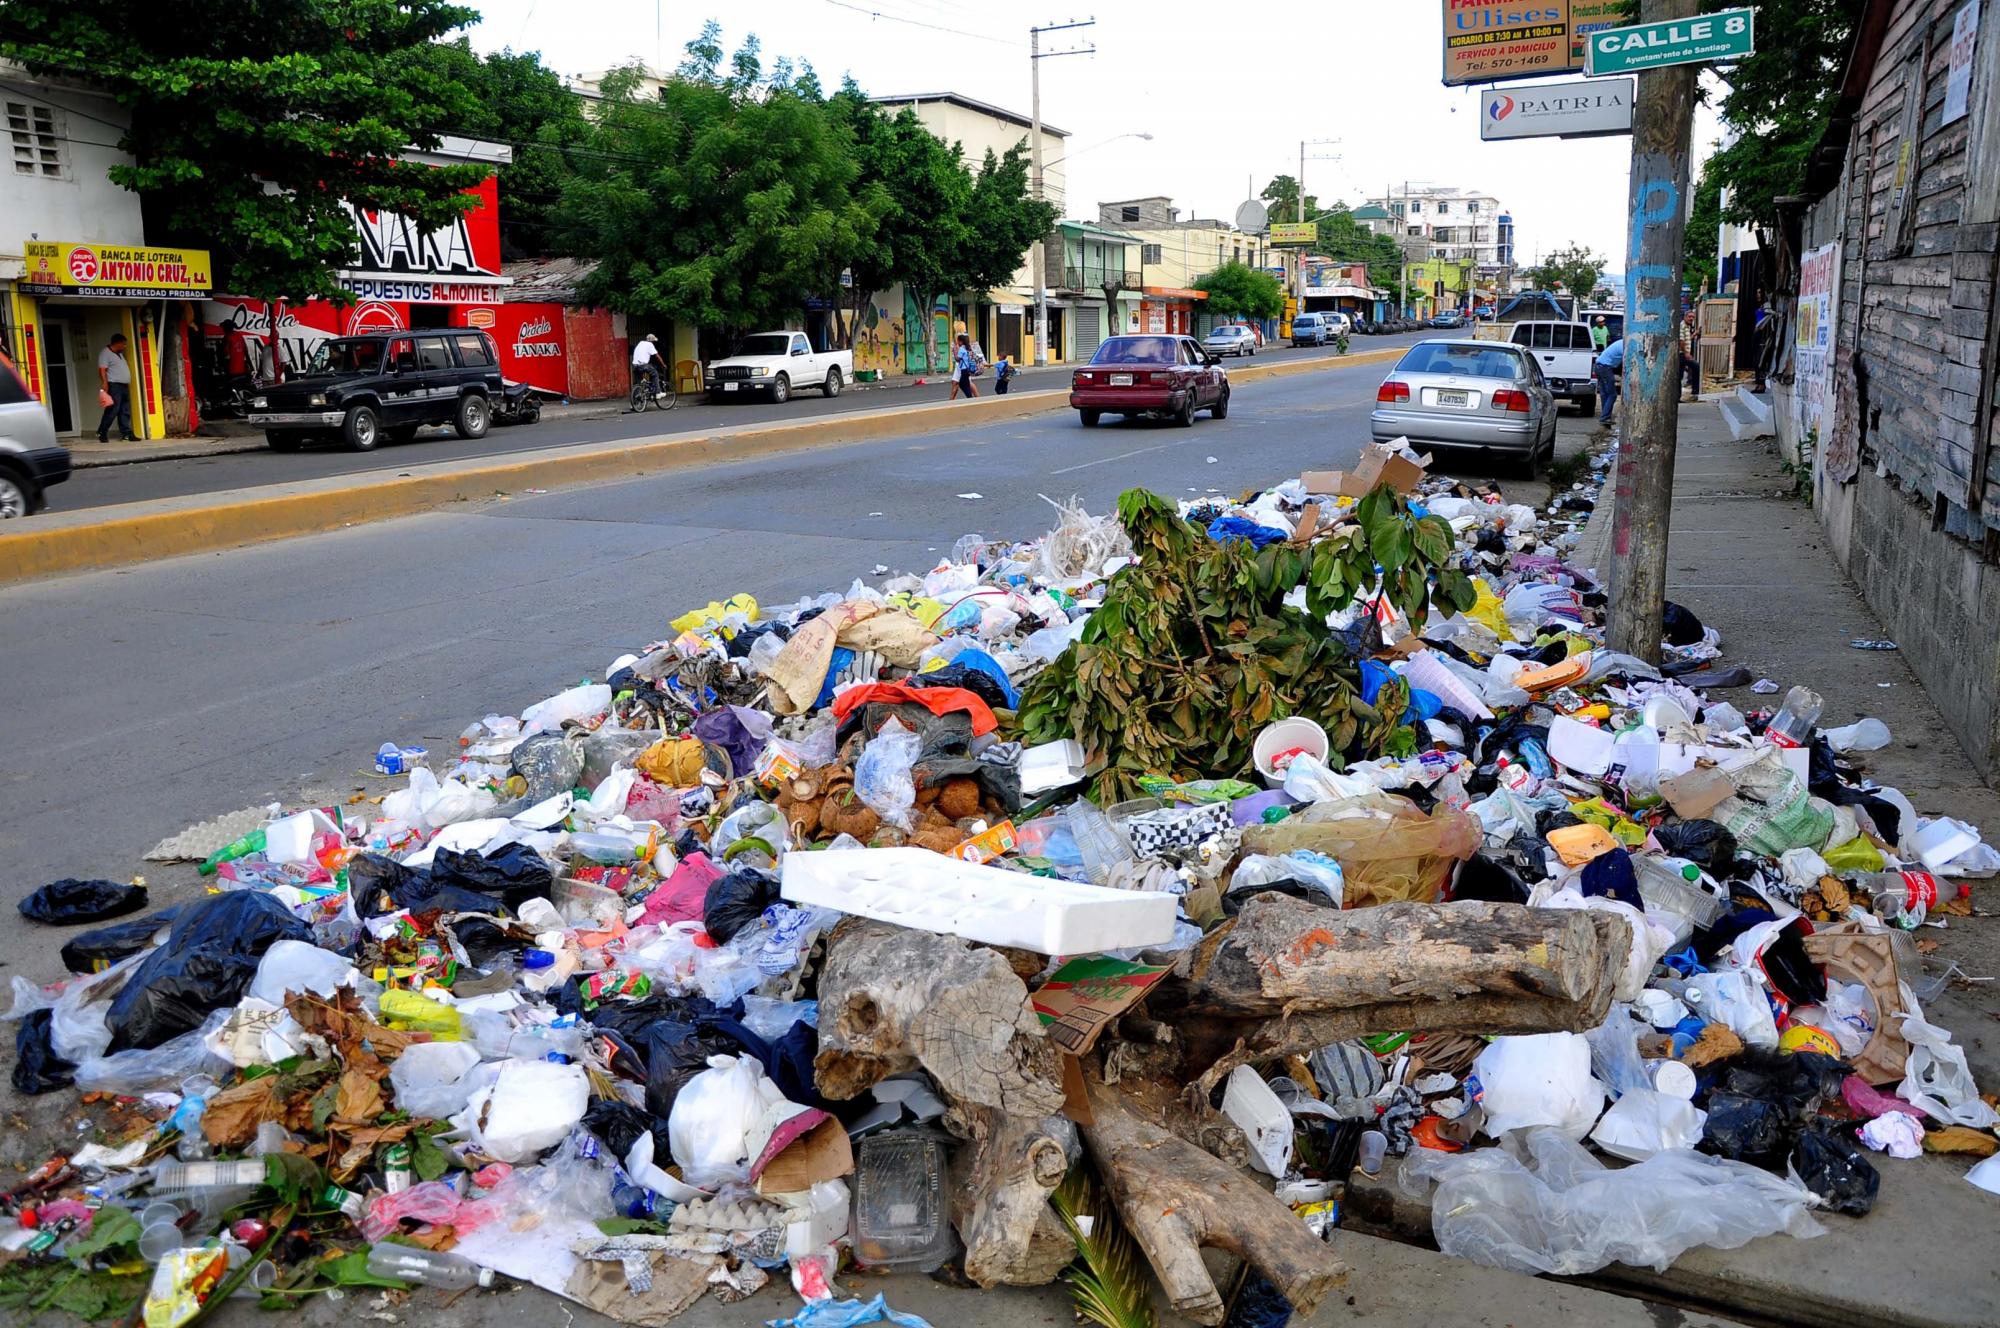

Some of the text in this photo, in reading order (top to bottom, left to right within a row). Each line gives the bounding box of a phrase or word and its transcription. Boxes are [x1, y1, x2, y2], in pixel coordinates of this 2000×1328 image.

[1456, 8, 1560, 30] Ulises
[1450, 26, 1562, 47] HORARIO DE 7:30 AM A 10:00 PM
[1598, 16, 1746, 54] CALLE 8
[1456, 41, 1557, 60] SERVICIO A DOMICILIO
[1625, 42, 1731, 65] Ayuntamiento de Santiago
[1466, 54, 1549, 71] Tel: 570-1469
[1520, 94, 1623, 113] PATRIA
[101, 250, 183, 263] BANCA DE LOTERIA
[72, 260, 98, 280] ac
[100, 261, 154, 282] ANTONIO
[158, 263, 191, 287] CRUZ,
[78, 287, 205, 298] SOLIDEZ Y SERIEDAD PROBADA
[513, 343, 561, 357] TANAKA
